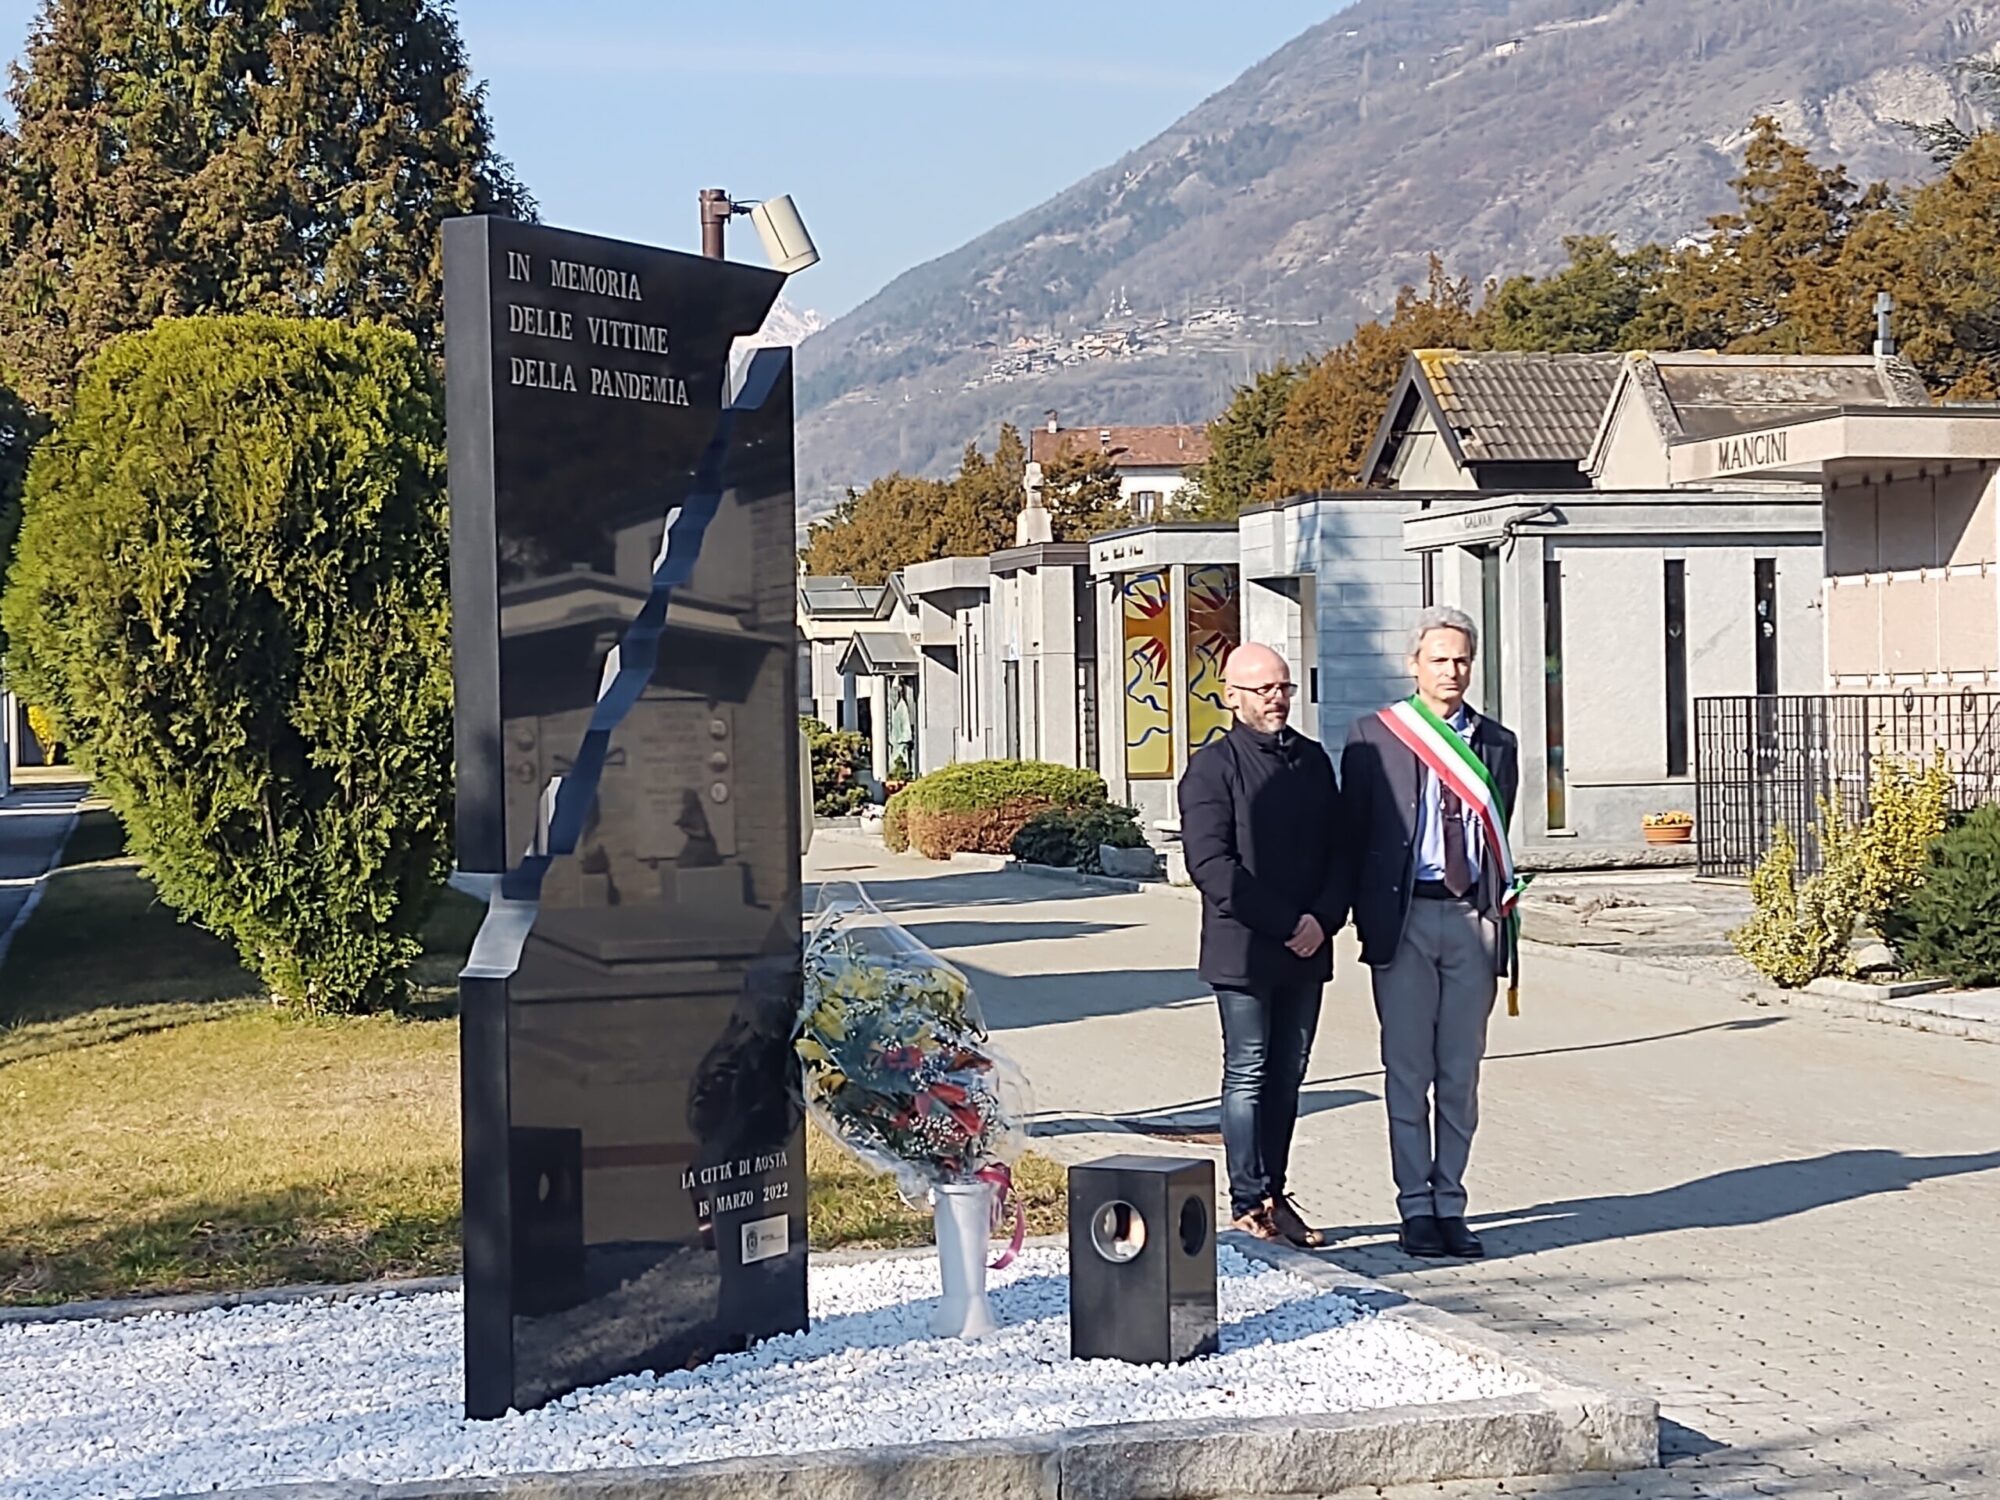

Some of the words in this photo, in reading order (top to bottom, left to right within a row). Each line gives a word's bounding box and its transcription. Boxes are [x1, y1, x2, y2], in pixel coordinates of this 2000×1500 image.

[507, 251, 530, 282] IN
[550, 259, 642, 301] MEMORIA
[509, 304, 573, 340] DELLE
[587, 317, 669, 354] VITTIME
[510, 357, 577, 392] DELLA
[590, 367, 690, 406] PANDEMIA
[1718, 431, 1787, 471] MANCINI
[681, 1171, 696, 1190] LA
[738, 1159, 751, 1177] DI
[754, 1151, 788, 1173] AOSTA
[698, 1200, 710, 1217] 18
[716, 1190, 754, 1213] MARZO
[762, 1182, 788, 1202] 2022
